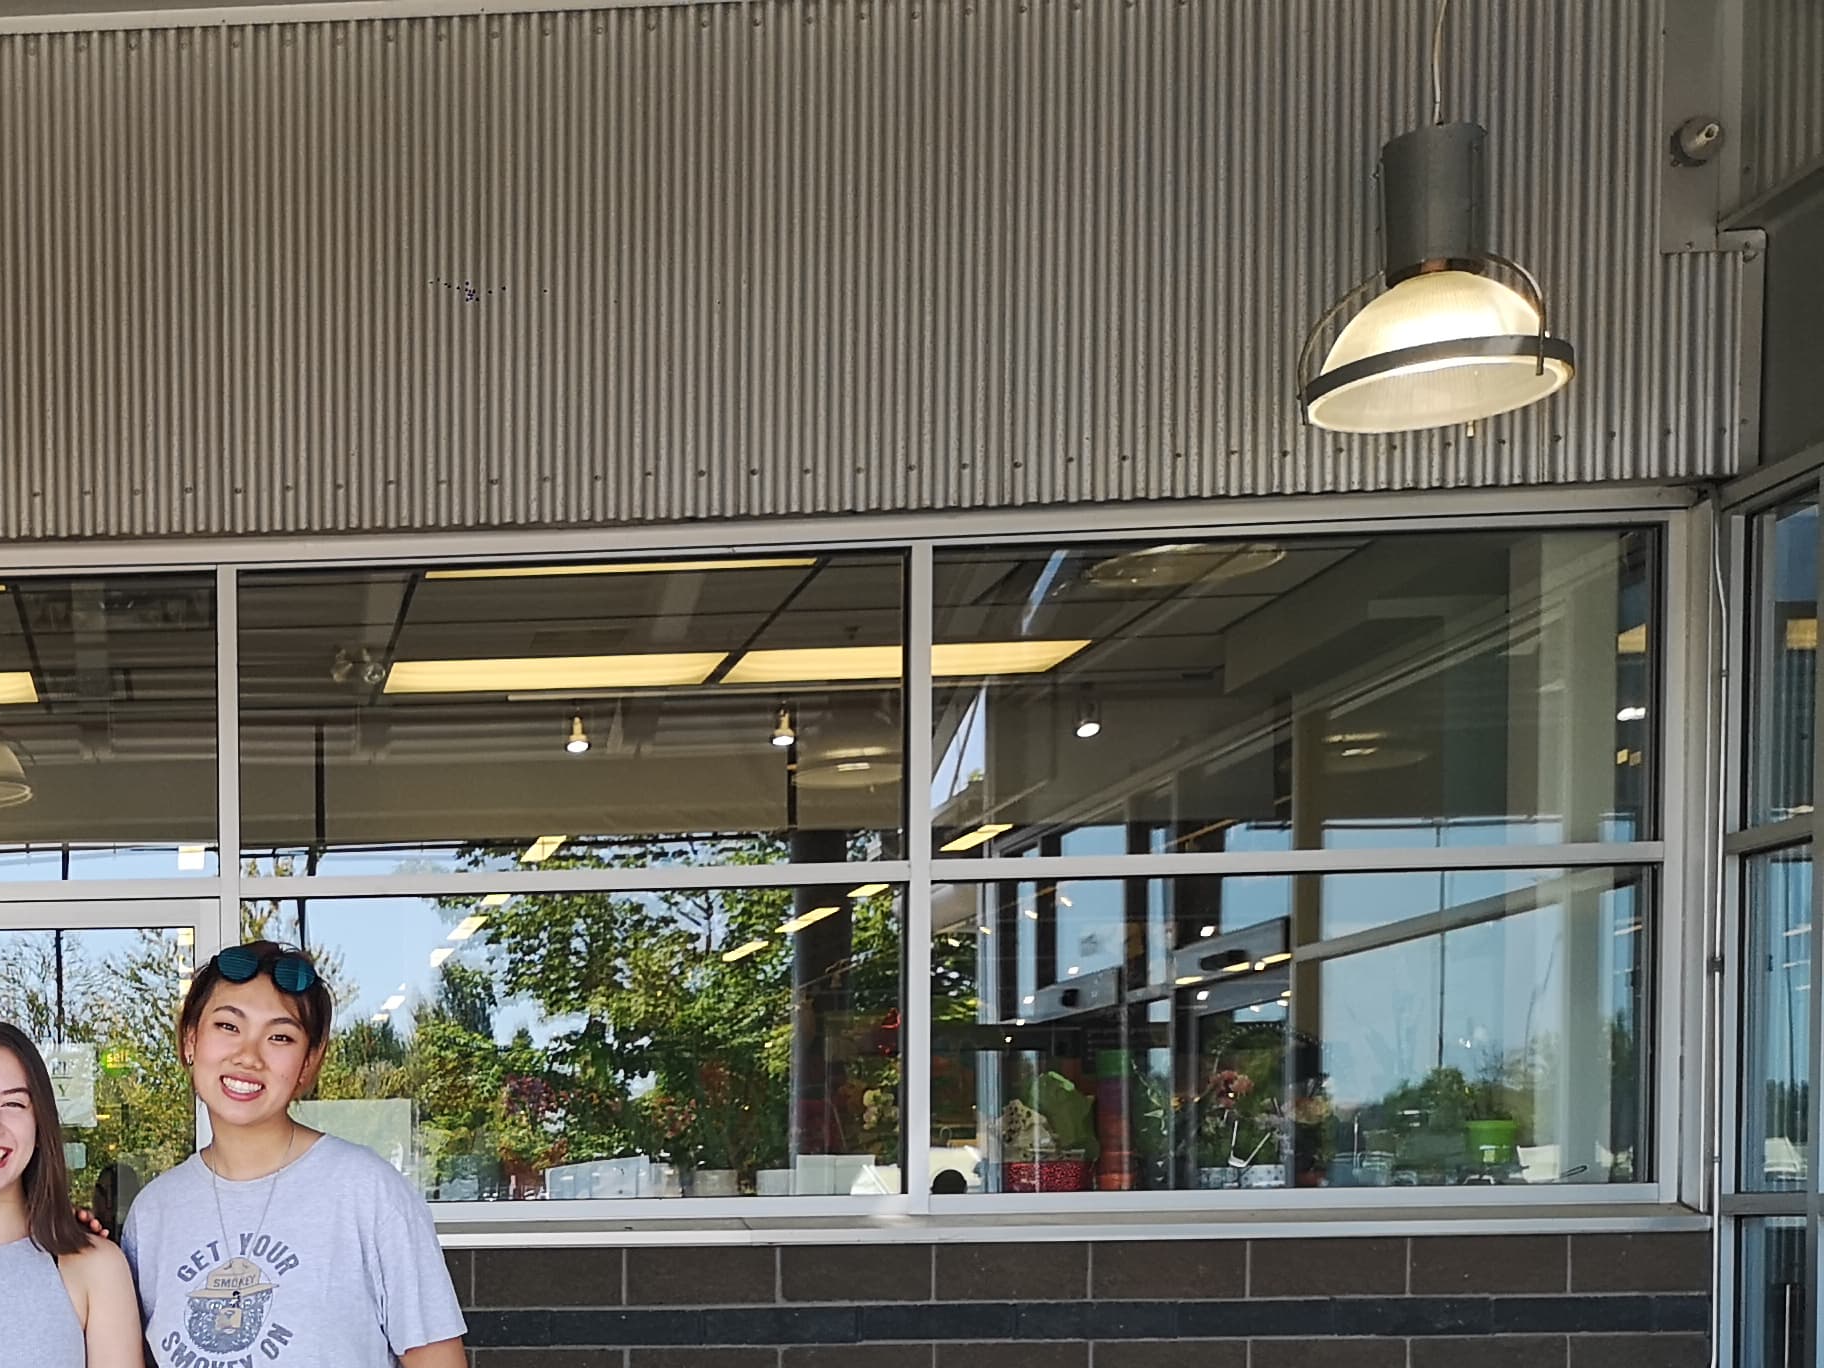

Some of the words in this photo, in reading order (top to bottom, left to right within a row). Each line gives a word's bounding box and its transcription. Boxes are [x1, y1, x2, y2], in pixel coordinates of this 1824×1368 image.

[177, 1240, 221, 1283] GET
[239, 1232, 300, 1277] YOUR
[213, 1274, 257, 1288] SMOKEY
[260, 1322, 294, 1361] ON
